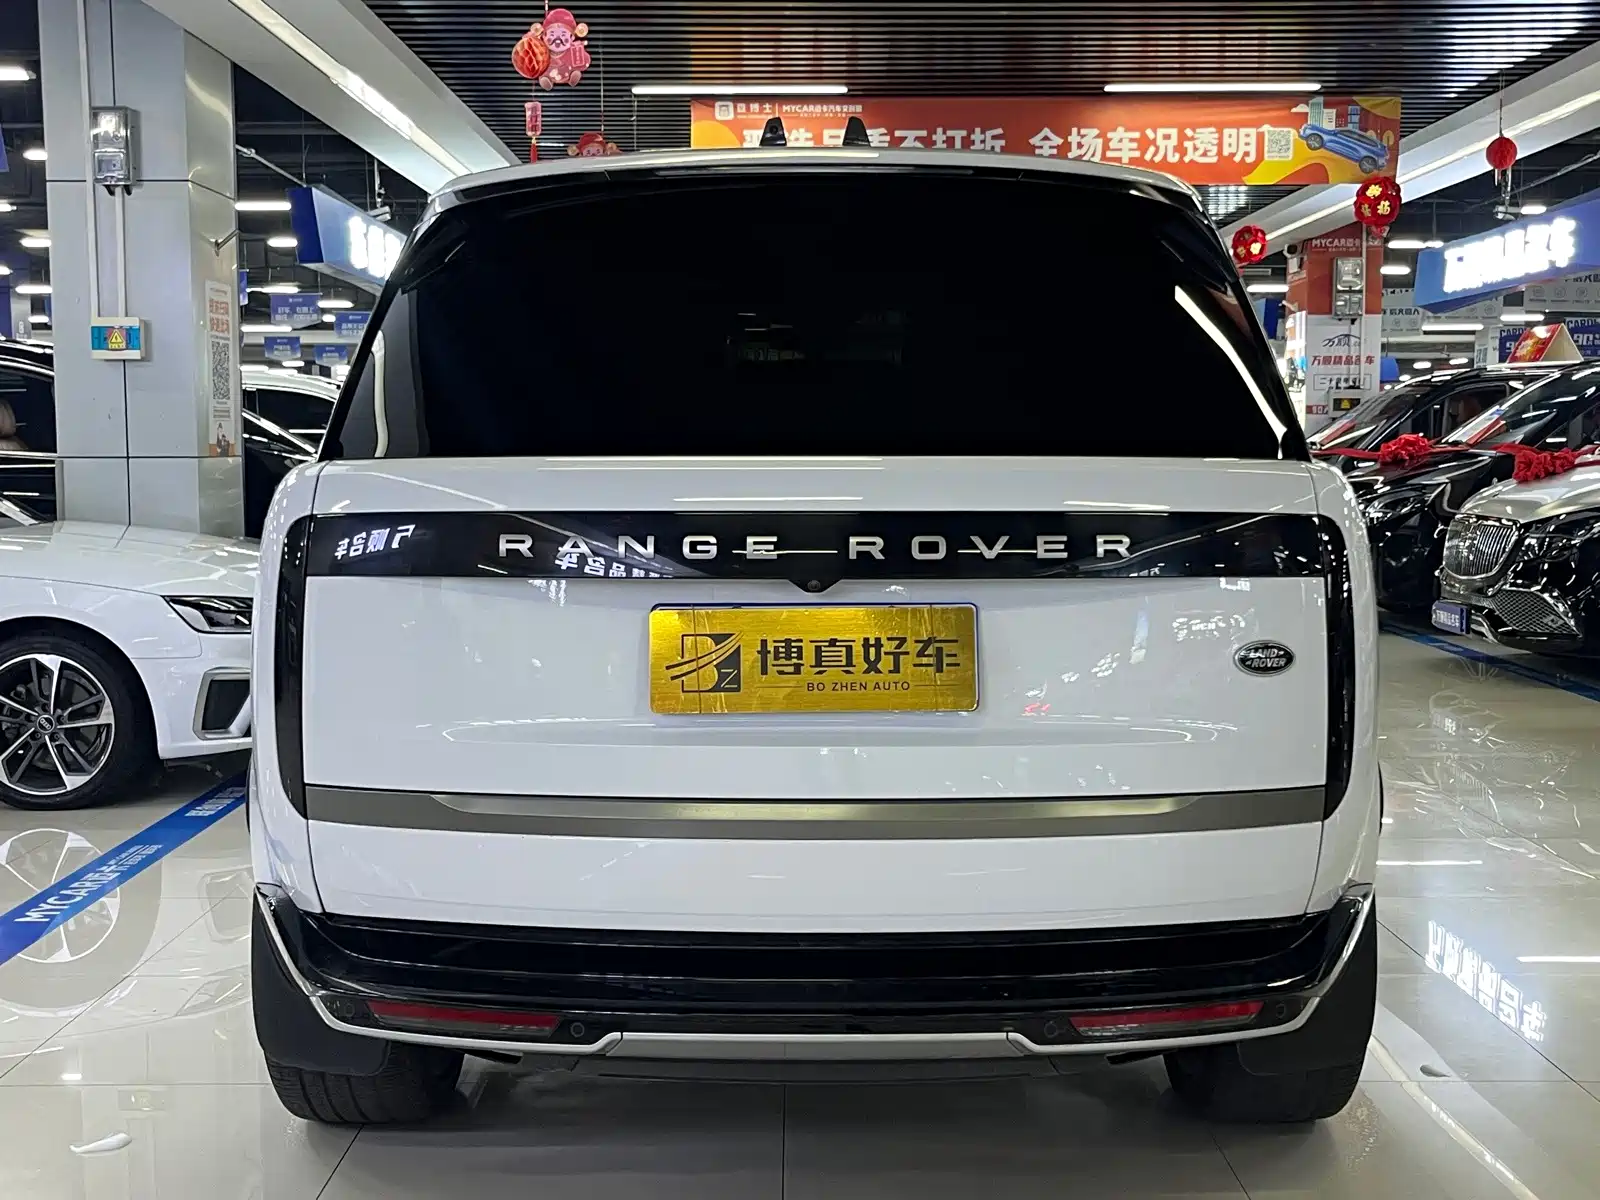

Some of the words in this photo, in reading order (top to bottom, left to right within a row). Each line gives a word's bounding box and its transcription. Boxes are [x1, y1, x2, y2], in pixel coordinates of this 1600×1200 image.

[1029, 127, 1257, 164] 全场车况透明
[499, 534, 778, 560] RANGE
[849, 534, 1132, 560] ROVER
[756, 636, 961, 676] 博真好车
[806, 681, 826, 692] BO
[831, 681, 867, 692] ZHEN
[872, 681, 911, 692] AUTO
